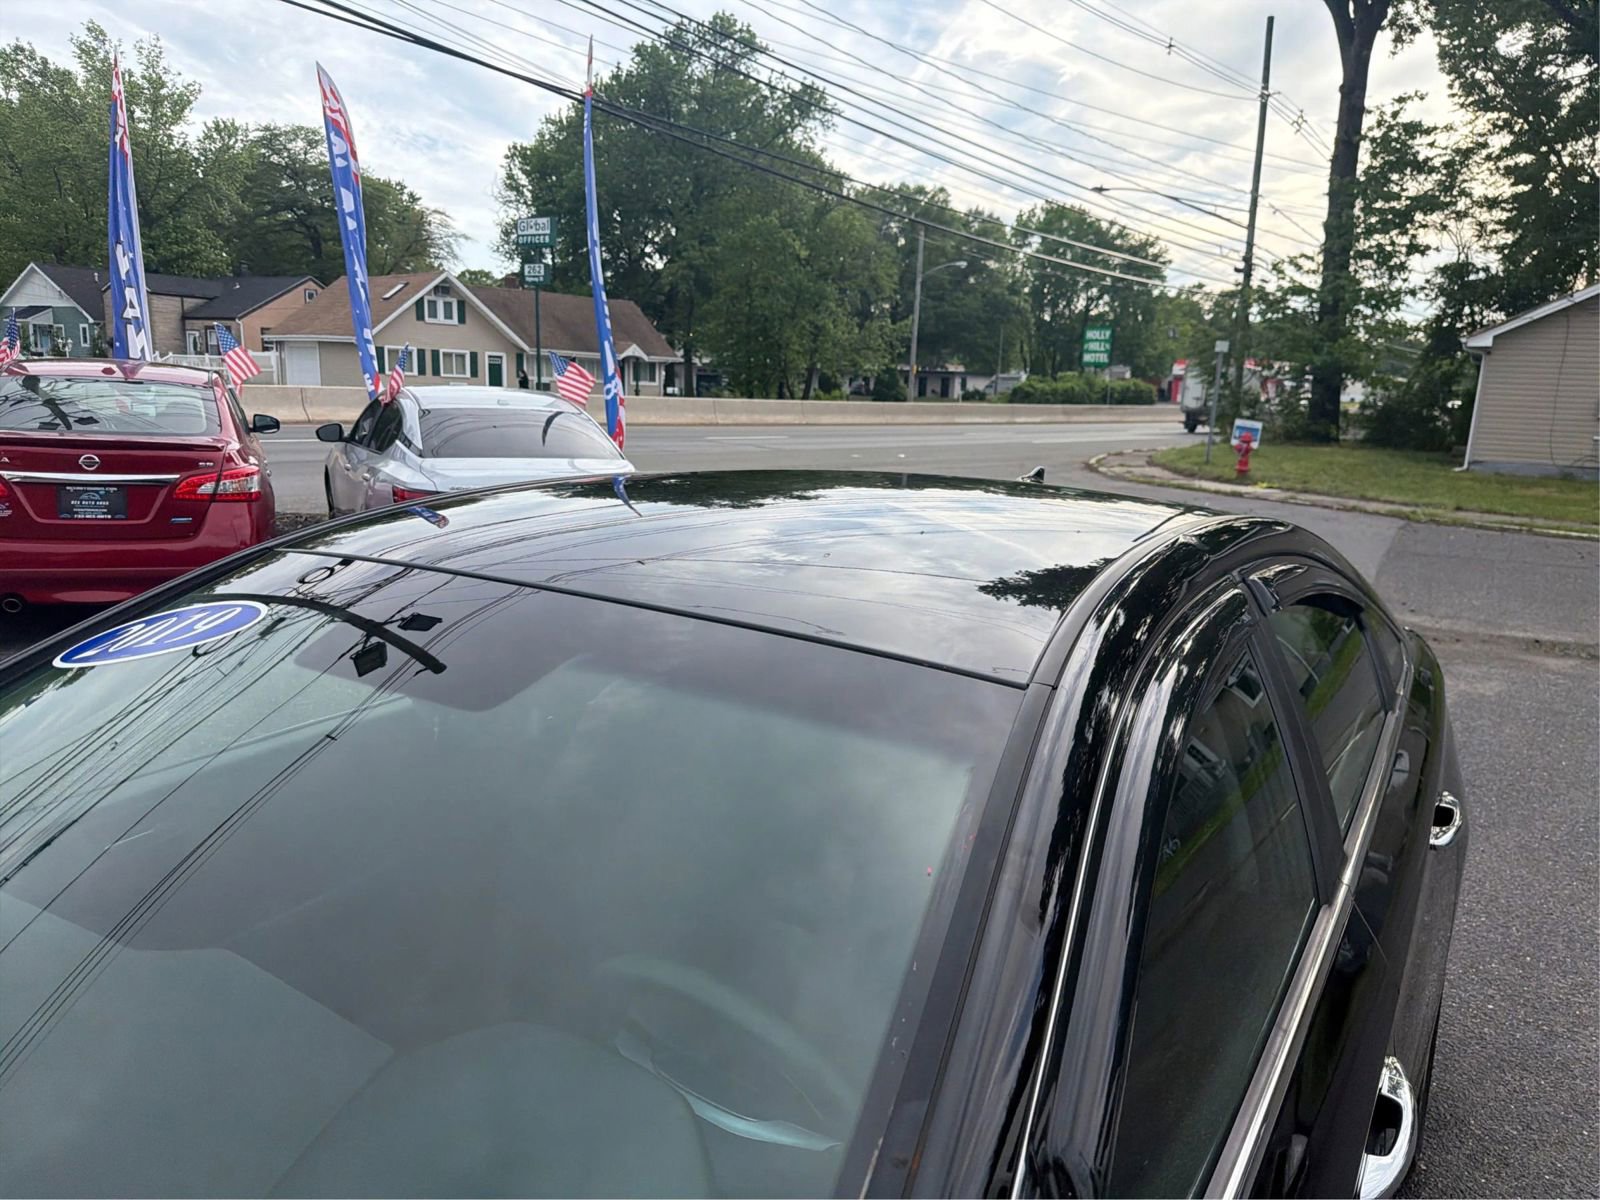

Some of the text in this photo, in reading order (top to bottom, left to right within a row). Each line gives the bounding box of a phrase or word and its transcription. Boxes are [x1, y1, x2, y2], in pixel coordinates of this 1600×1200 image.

[518, 235, 550, 244] OFFICES
[1086, 330, 1112, 340] HOLLY
[1088, 341, 1105, 351] HILL
[1083, 352, 1109, 363] MOTEL
[72, 607, 242, 660] 2019
